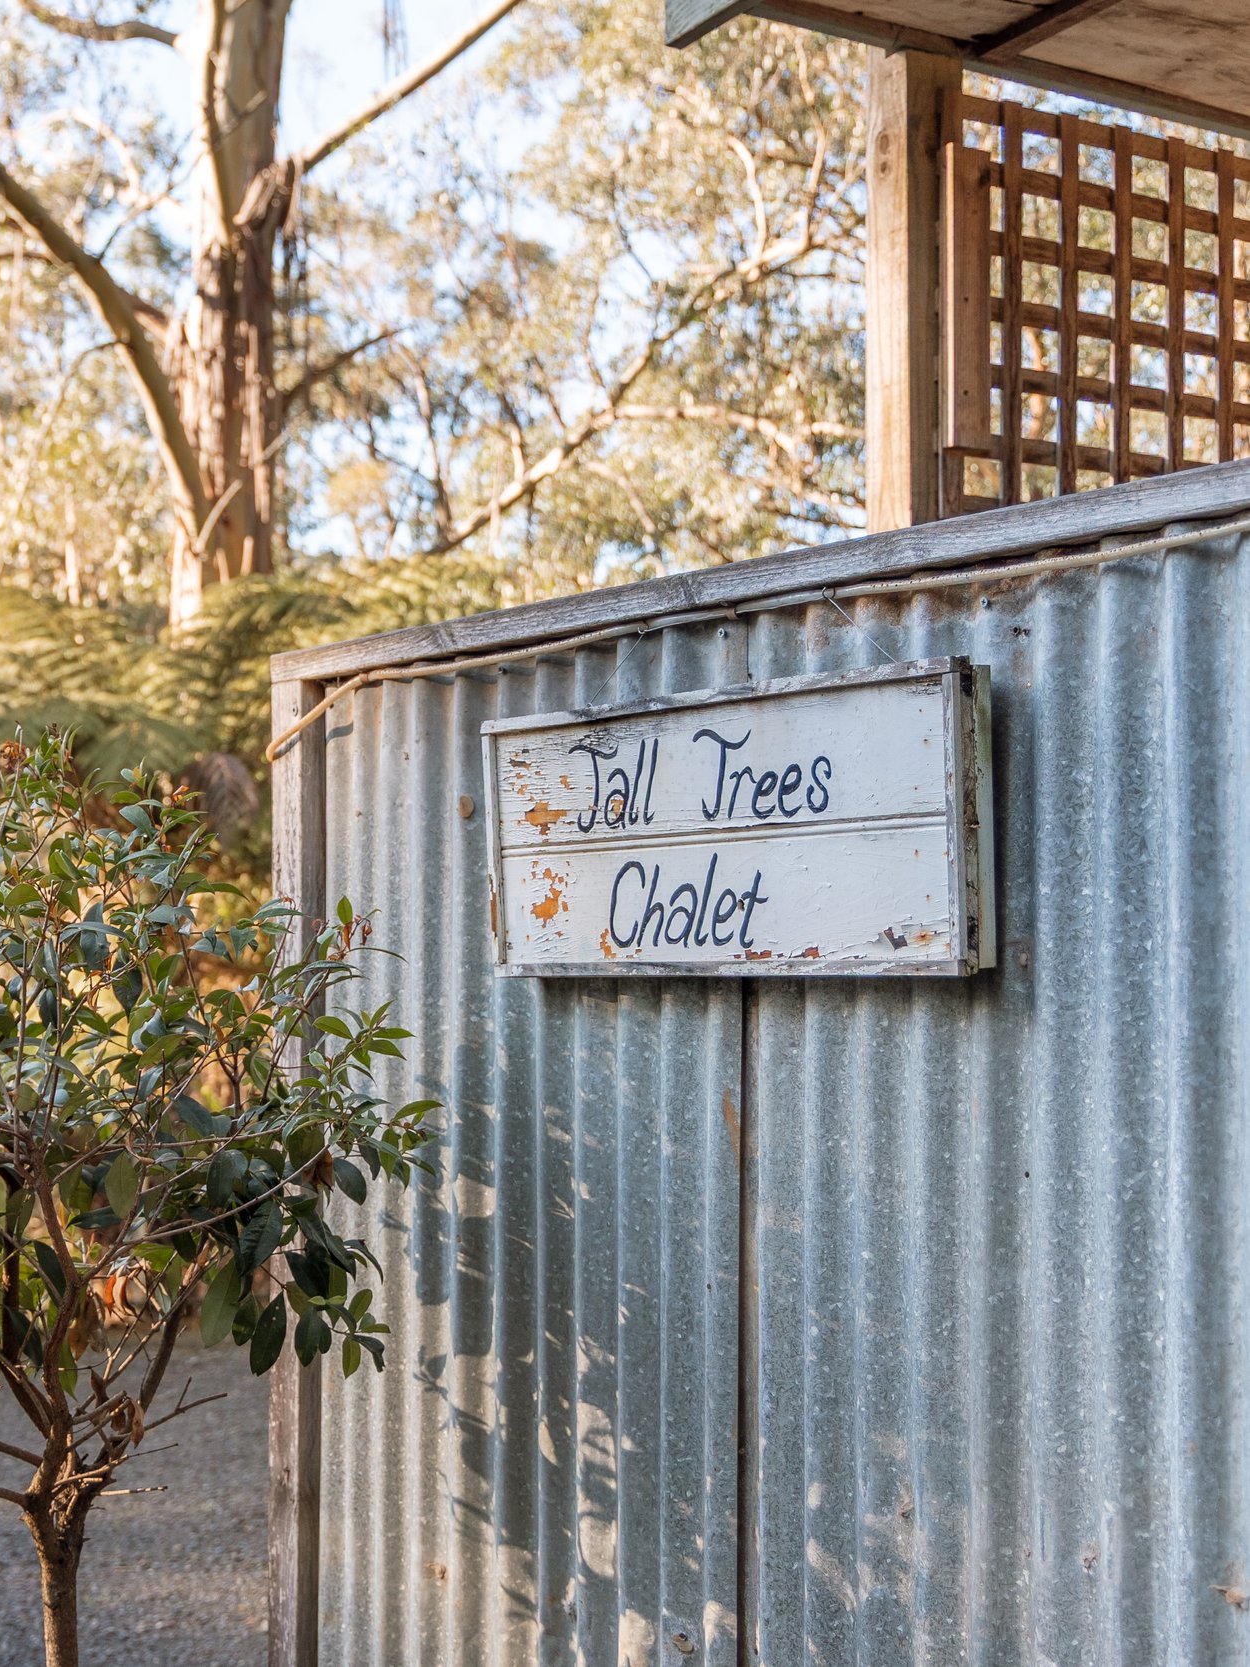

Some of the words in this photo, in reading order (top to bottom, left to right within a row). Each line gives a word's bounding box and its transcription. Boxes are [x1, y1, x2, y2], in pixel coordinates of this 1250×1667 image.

[568, 738, 659, 834] Tall
[692, 728, 832, 822] Trees
[609, 852, 769, 948] Chalet
